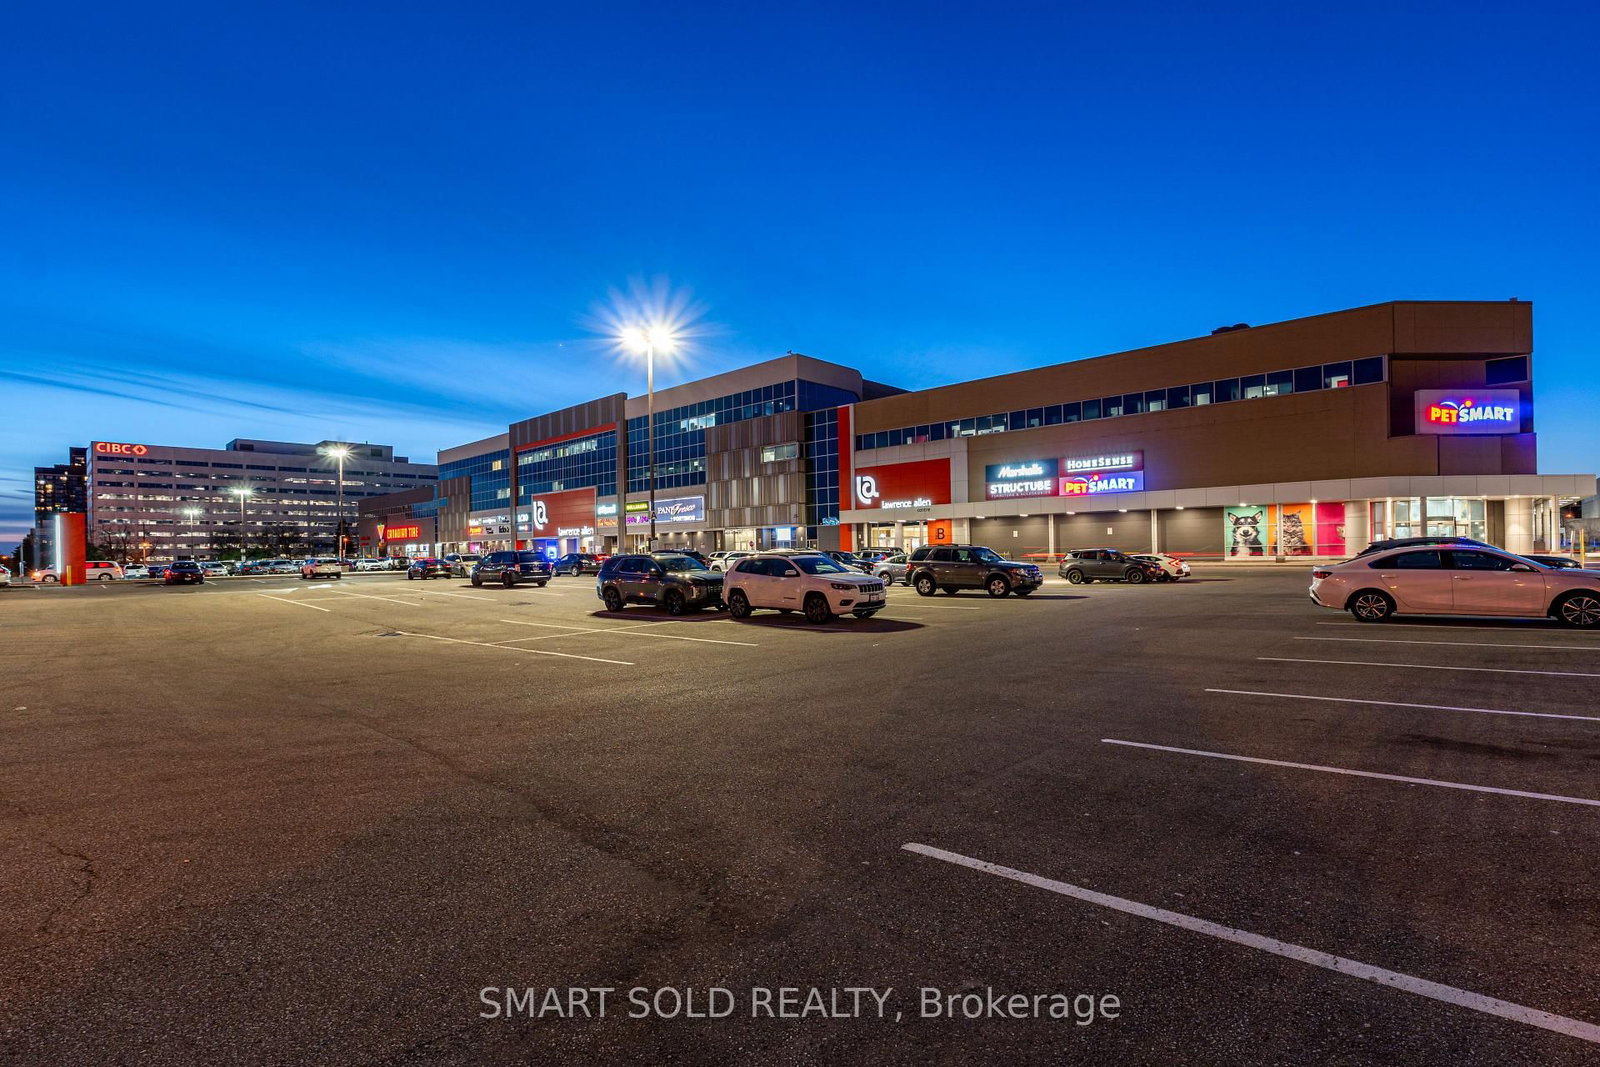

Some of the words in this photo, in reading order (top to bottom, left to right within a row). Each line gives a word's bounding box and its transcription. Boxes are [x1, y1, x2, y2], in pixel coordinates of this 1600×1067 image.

[1431, 406, 1514, 422] PETSMART
[96, 442, 132, 455] CIBC
[998, 464, 1044, 478] Marshalls
[990, 480, 1052, 494] STRUCTUBE
[1065, 477, 1136, 494] PETSMART
[914, 498, 931, 507] allen
[408, 527, 419, 538] TIRE
[937, 528, 945, 540] B
